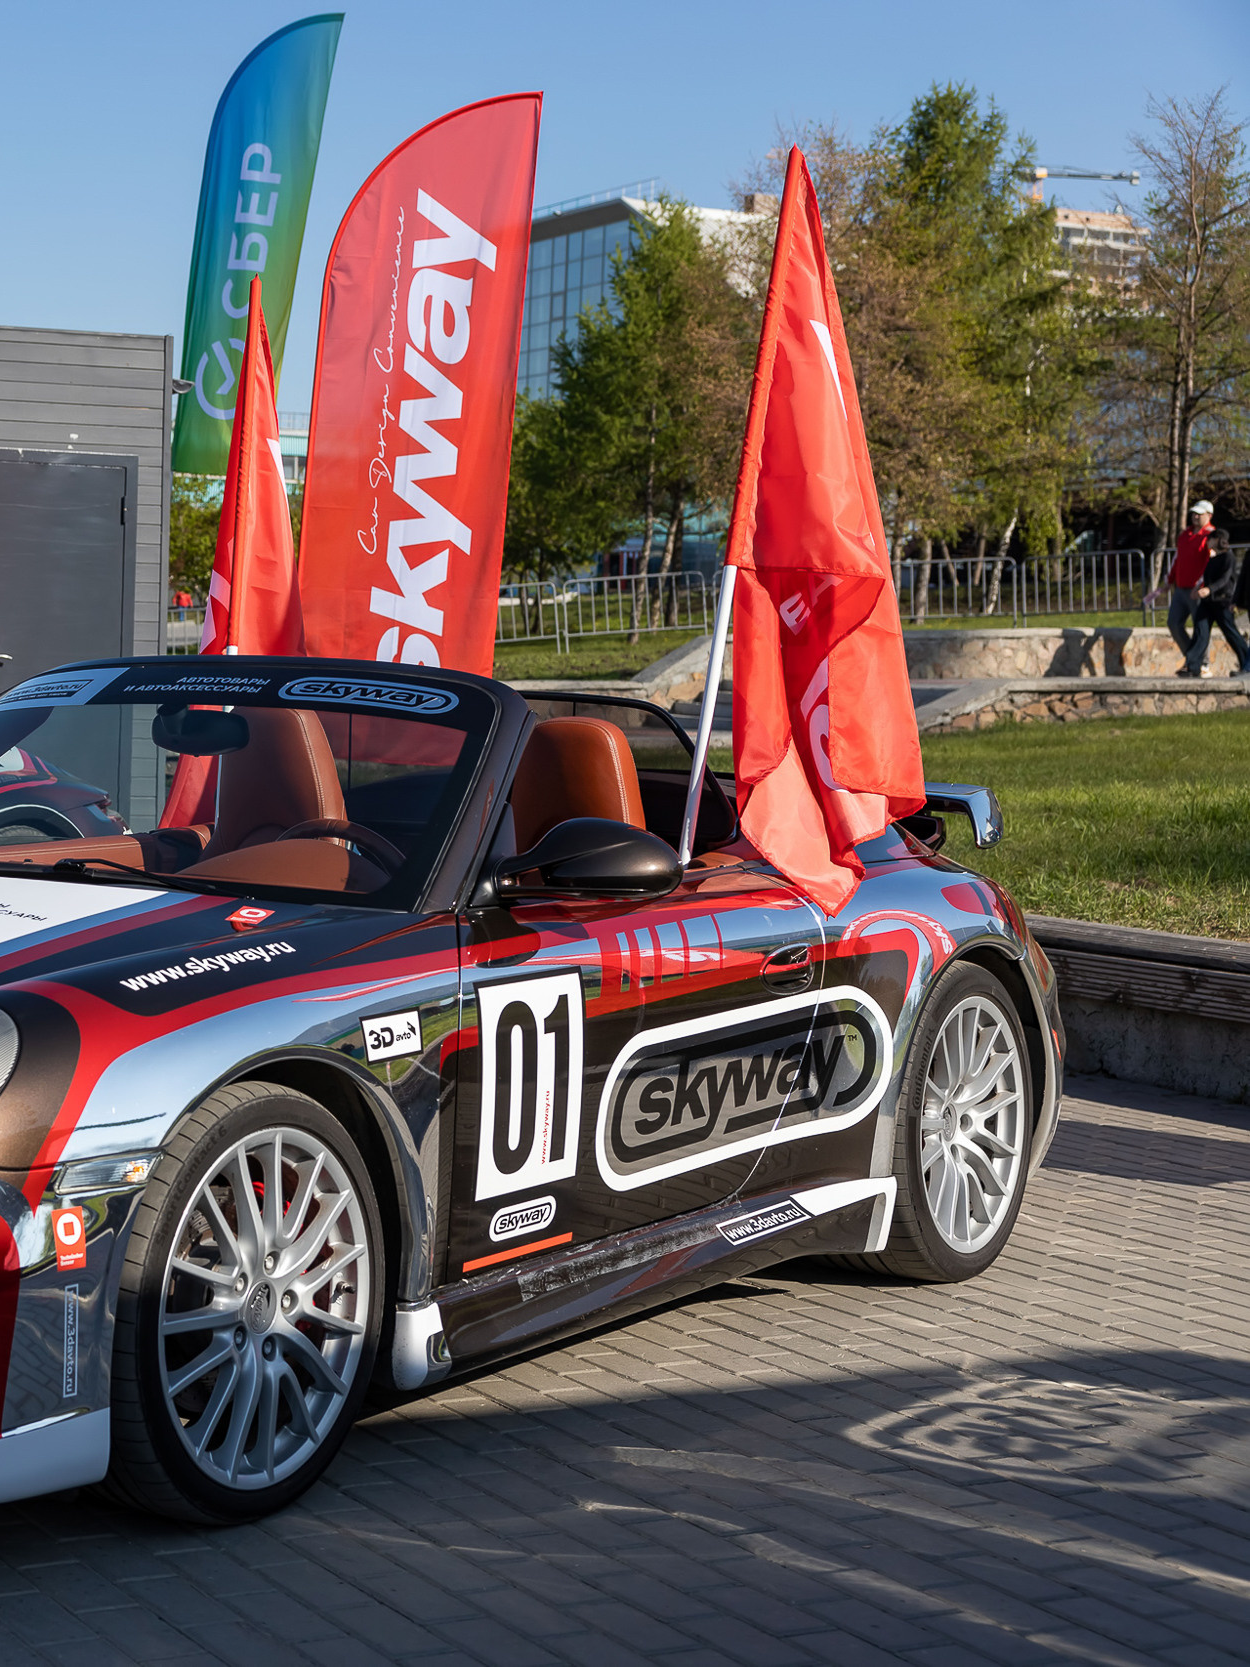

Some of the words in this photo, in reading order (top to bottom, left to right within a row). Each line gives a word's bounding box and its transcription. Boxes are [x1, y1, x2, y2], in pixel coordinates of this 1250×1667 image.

[222, 142, 282, 320] СБЕР
[373, 205, 405, 374] Convenience
[134, 684, 263, 694] АВТОАКСЕССУАРЫ
[176, 676, 272, 686] АВТОТОВАРЫ
[299, 682, 439, 705] skyway
[119, 941, 297, 991] www.skyway.ru
[369, 1026, 395, 1050] 3D
[395, 1029, 412, 1043] avto
[492, 993, 572, 1176] 01
[634, 1034, 847, 1137] skyway
[540, 1089, 551, 1165] www.skyway.ru
[498, 1206, 548, 1231] skyway
[726, 1205, 801, 1242] www.3davto.ru
[66, 1289, 76, 1393] www.3davto.ru
